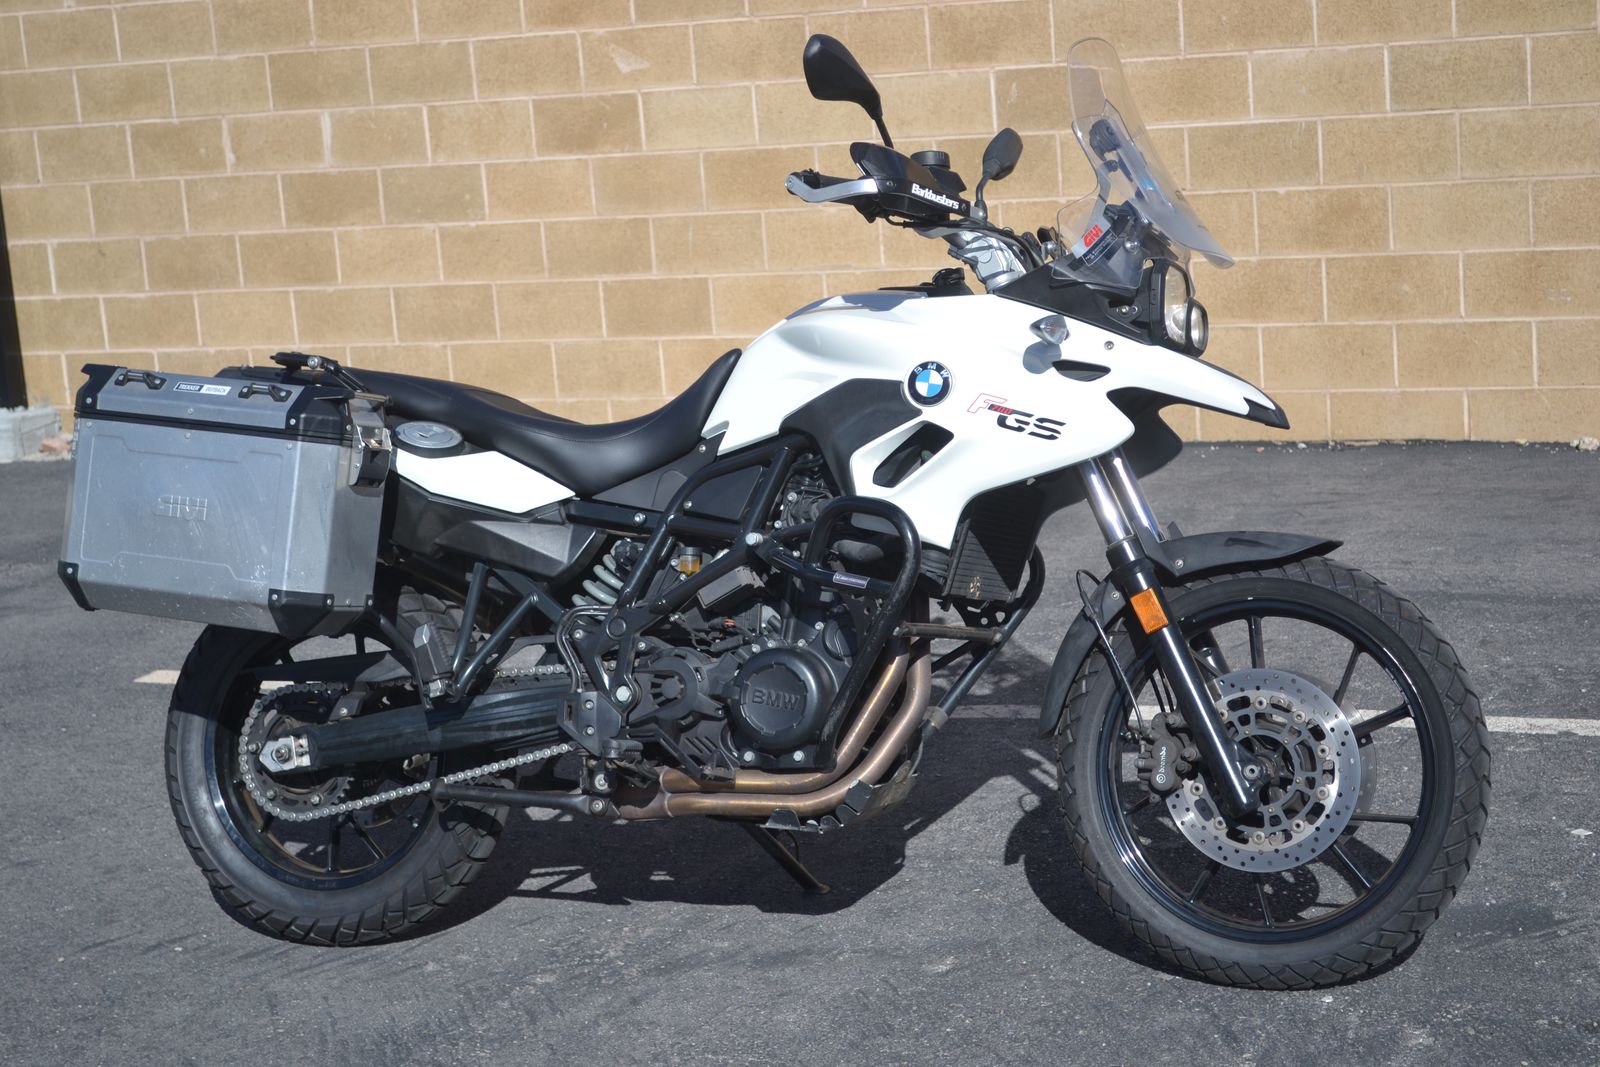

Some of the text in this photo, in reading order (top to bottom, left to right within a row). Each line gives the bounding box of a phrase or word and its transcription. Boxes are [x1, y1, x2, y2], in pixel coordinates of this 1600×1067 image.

[911, 182, 960, 210] Barkbusters
[1083, 223, 1104, 248] GIVI
[913, 362, 950, 378] BMW
[178, 383, 201, 391] TREKKER
[988, 404, 1067, 441] GS
[751, 688, 801, 711] BMW
[1158, 746, 1168, 773] brembo
